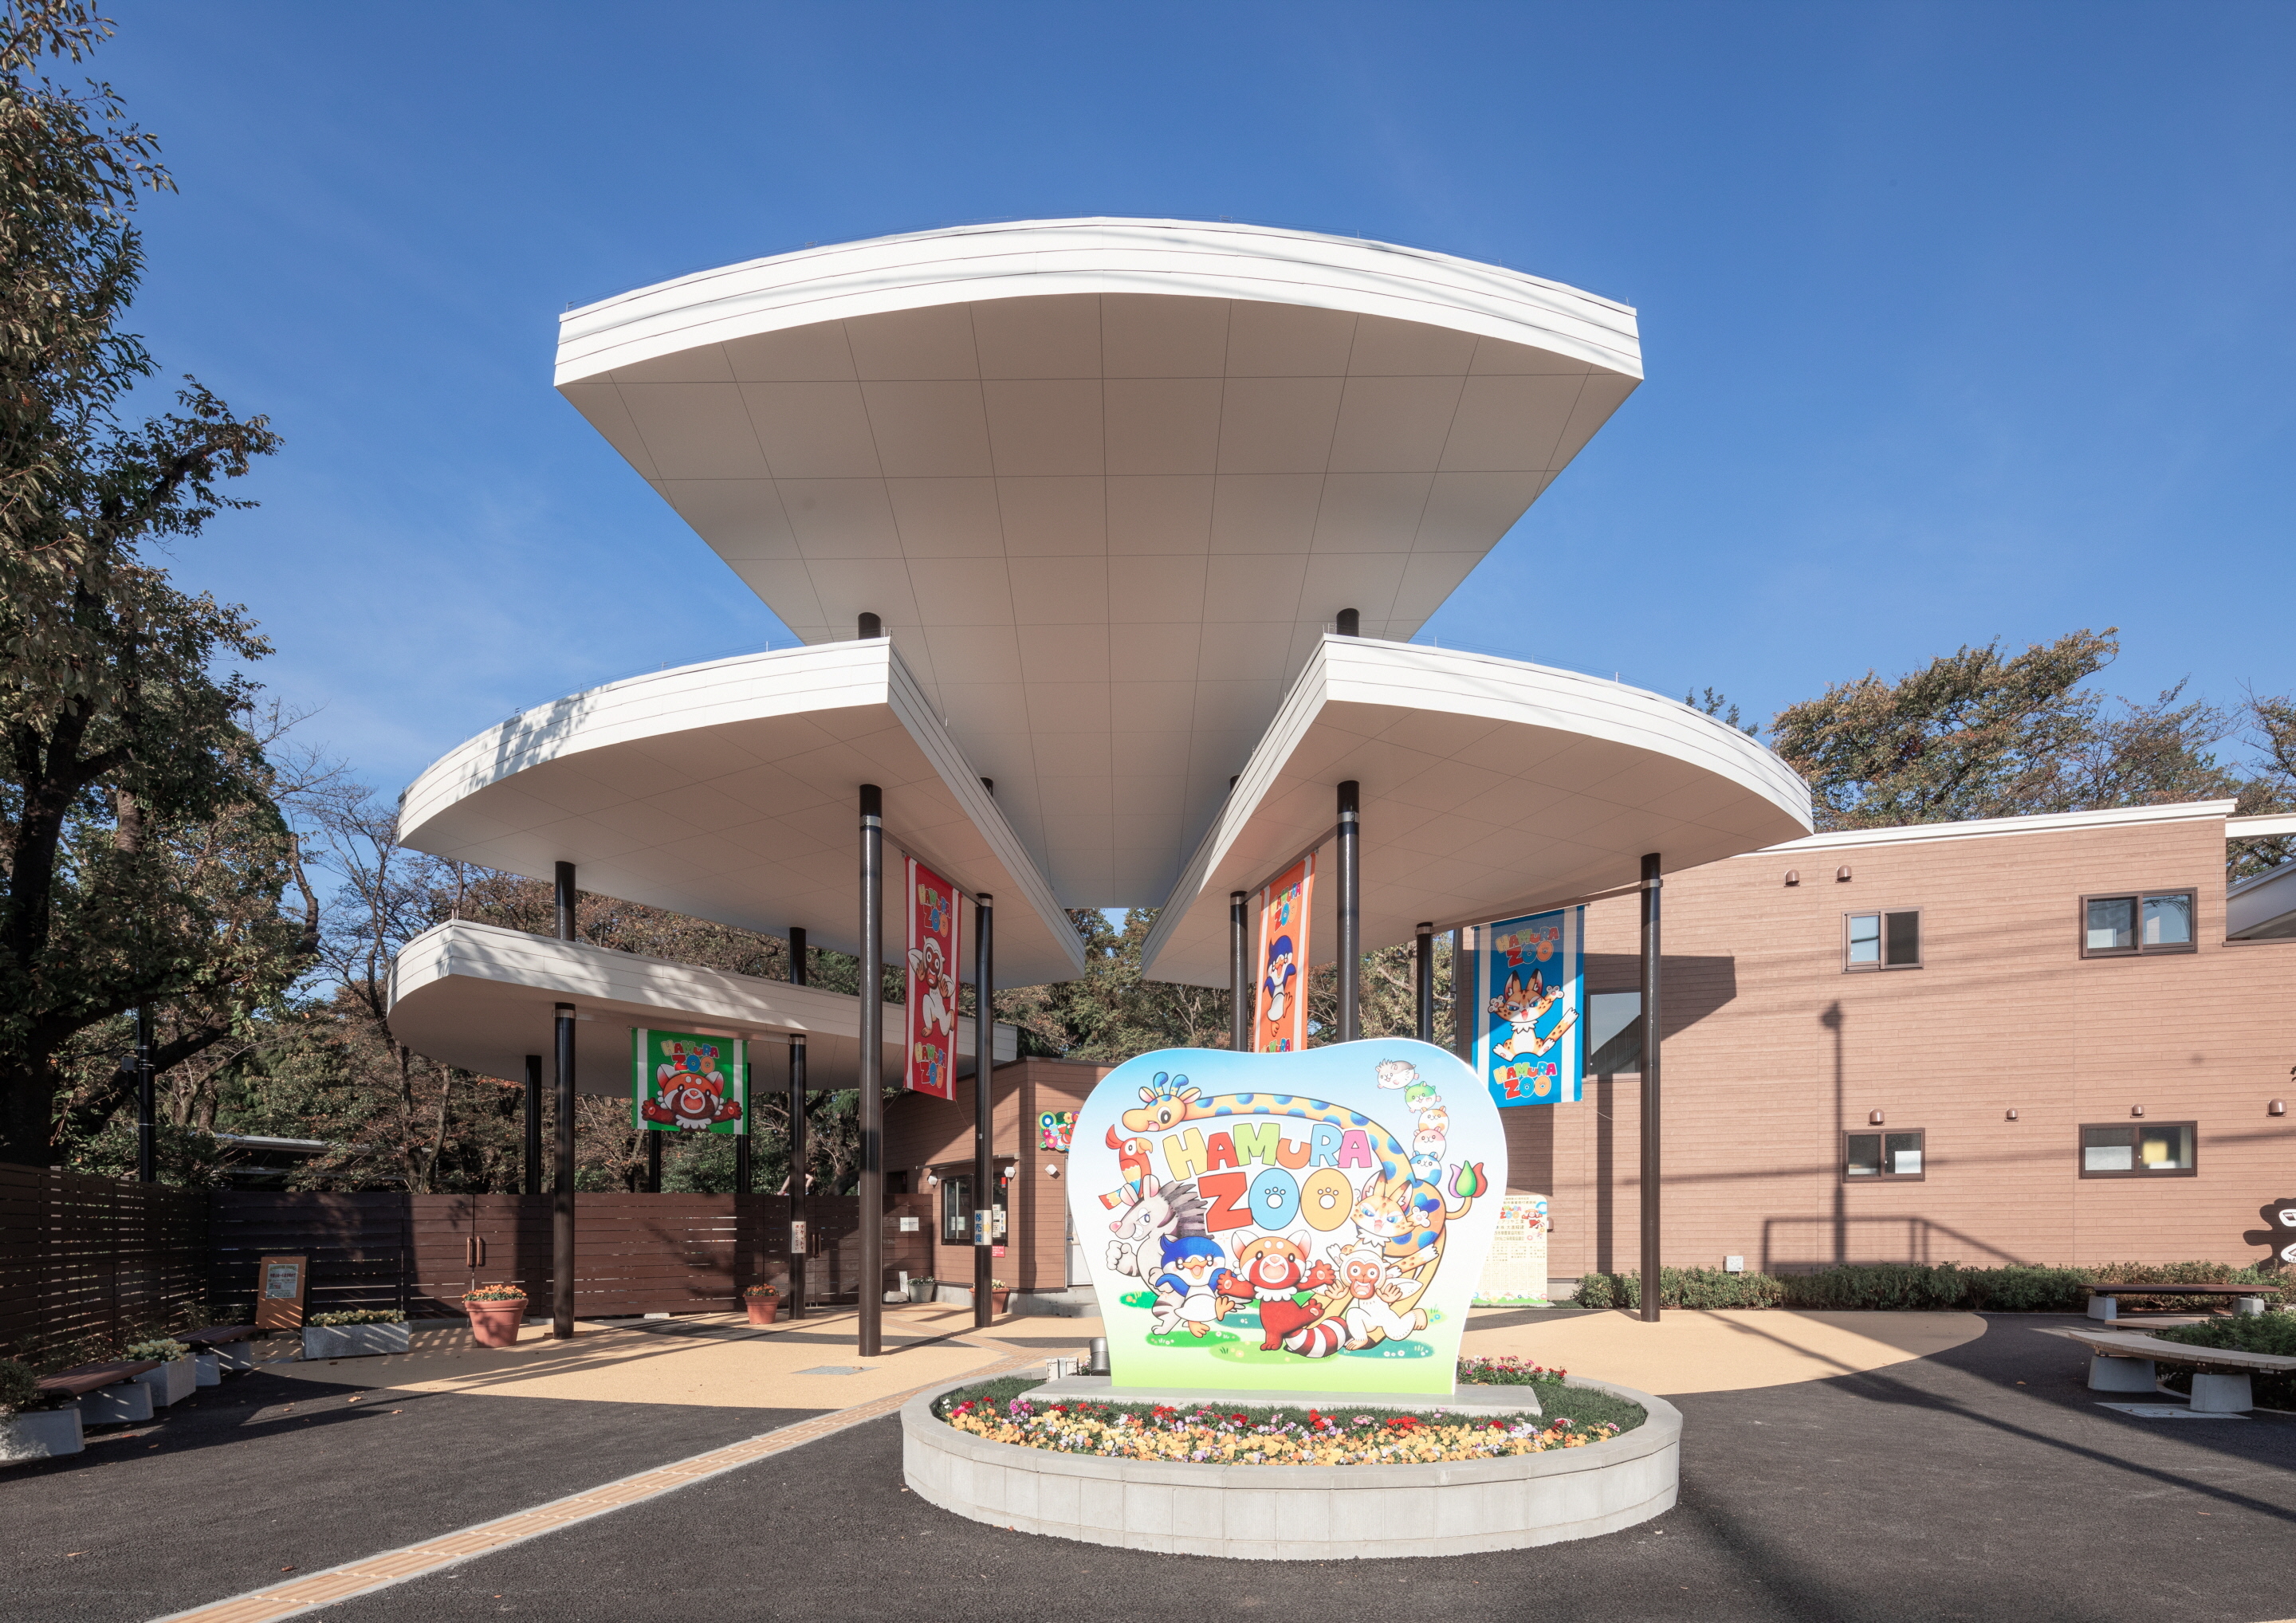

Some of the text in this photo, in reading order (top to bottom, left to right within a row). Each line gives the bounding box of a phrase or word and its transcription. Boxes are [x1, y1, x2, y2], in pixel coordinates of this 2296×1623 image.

[918, 884, 951, 918] HAMURA
[1271, 881, 1301, 918] HAMURA
[923, 904, 949, 937] ZOO
[1274, 898, 1297, 933] ZOO
[1495, 926, 1559, 953] HAMURA
[1505, 941, 1554, 968] ZOO
[661, 1039, 720, 1059] HAMURA
[914, 1042, 946, 1068] HAMURA
[671, 1054, 715, 1074] ZOO
[920, 1061, 944, 1088] ZOO
[1493, 1062, 1558, 1085] HAMURA
[1504, 1076, 1551, 1099] ZOO
[1162, 1122, 1373, 1181] HAMURA
[1197, 1169, 1354, 1232] ZOO
